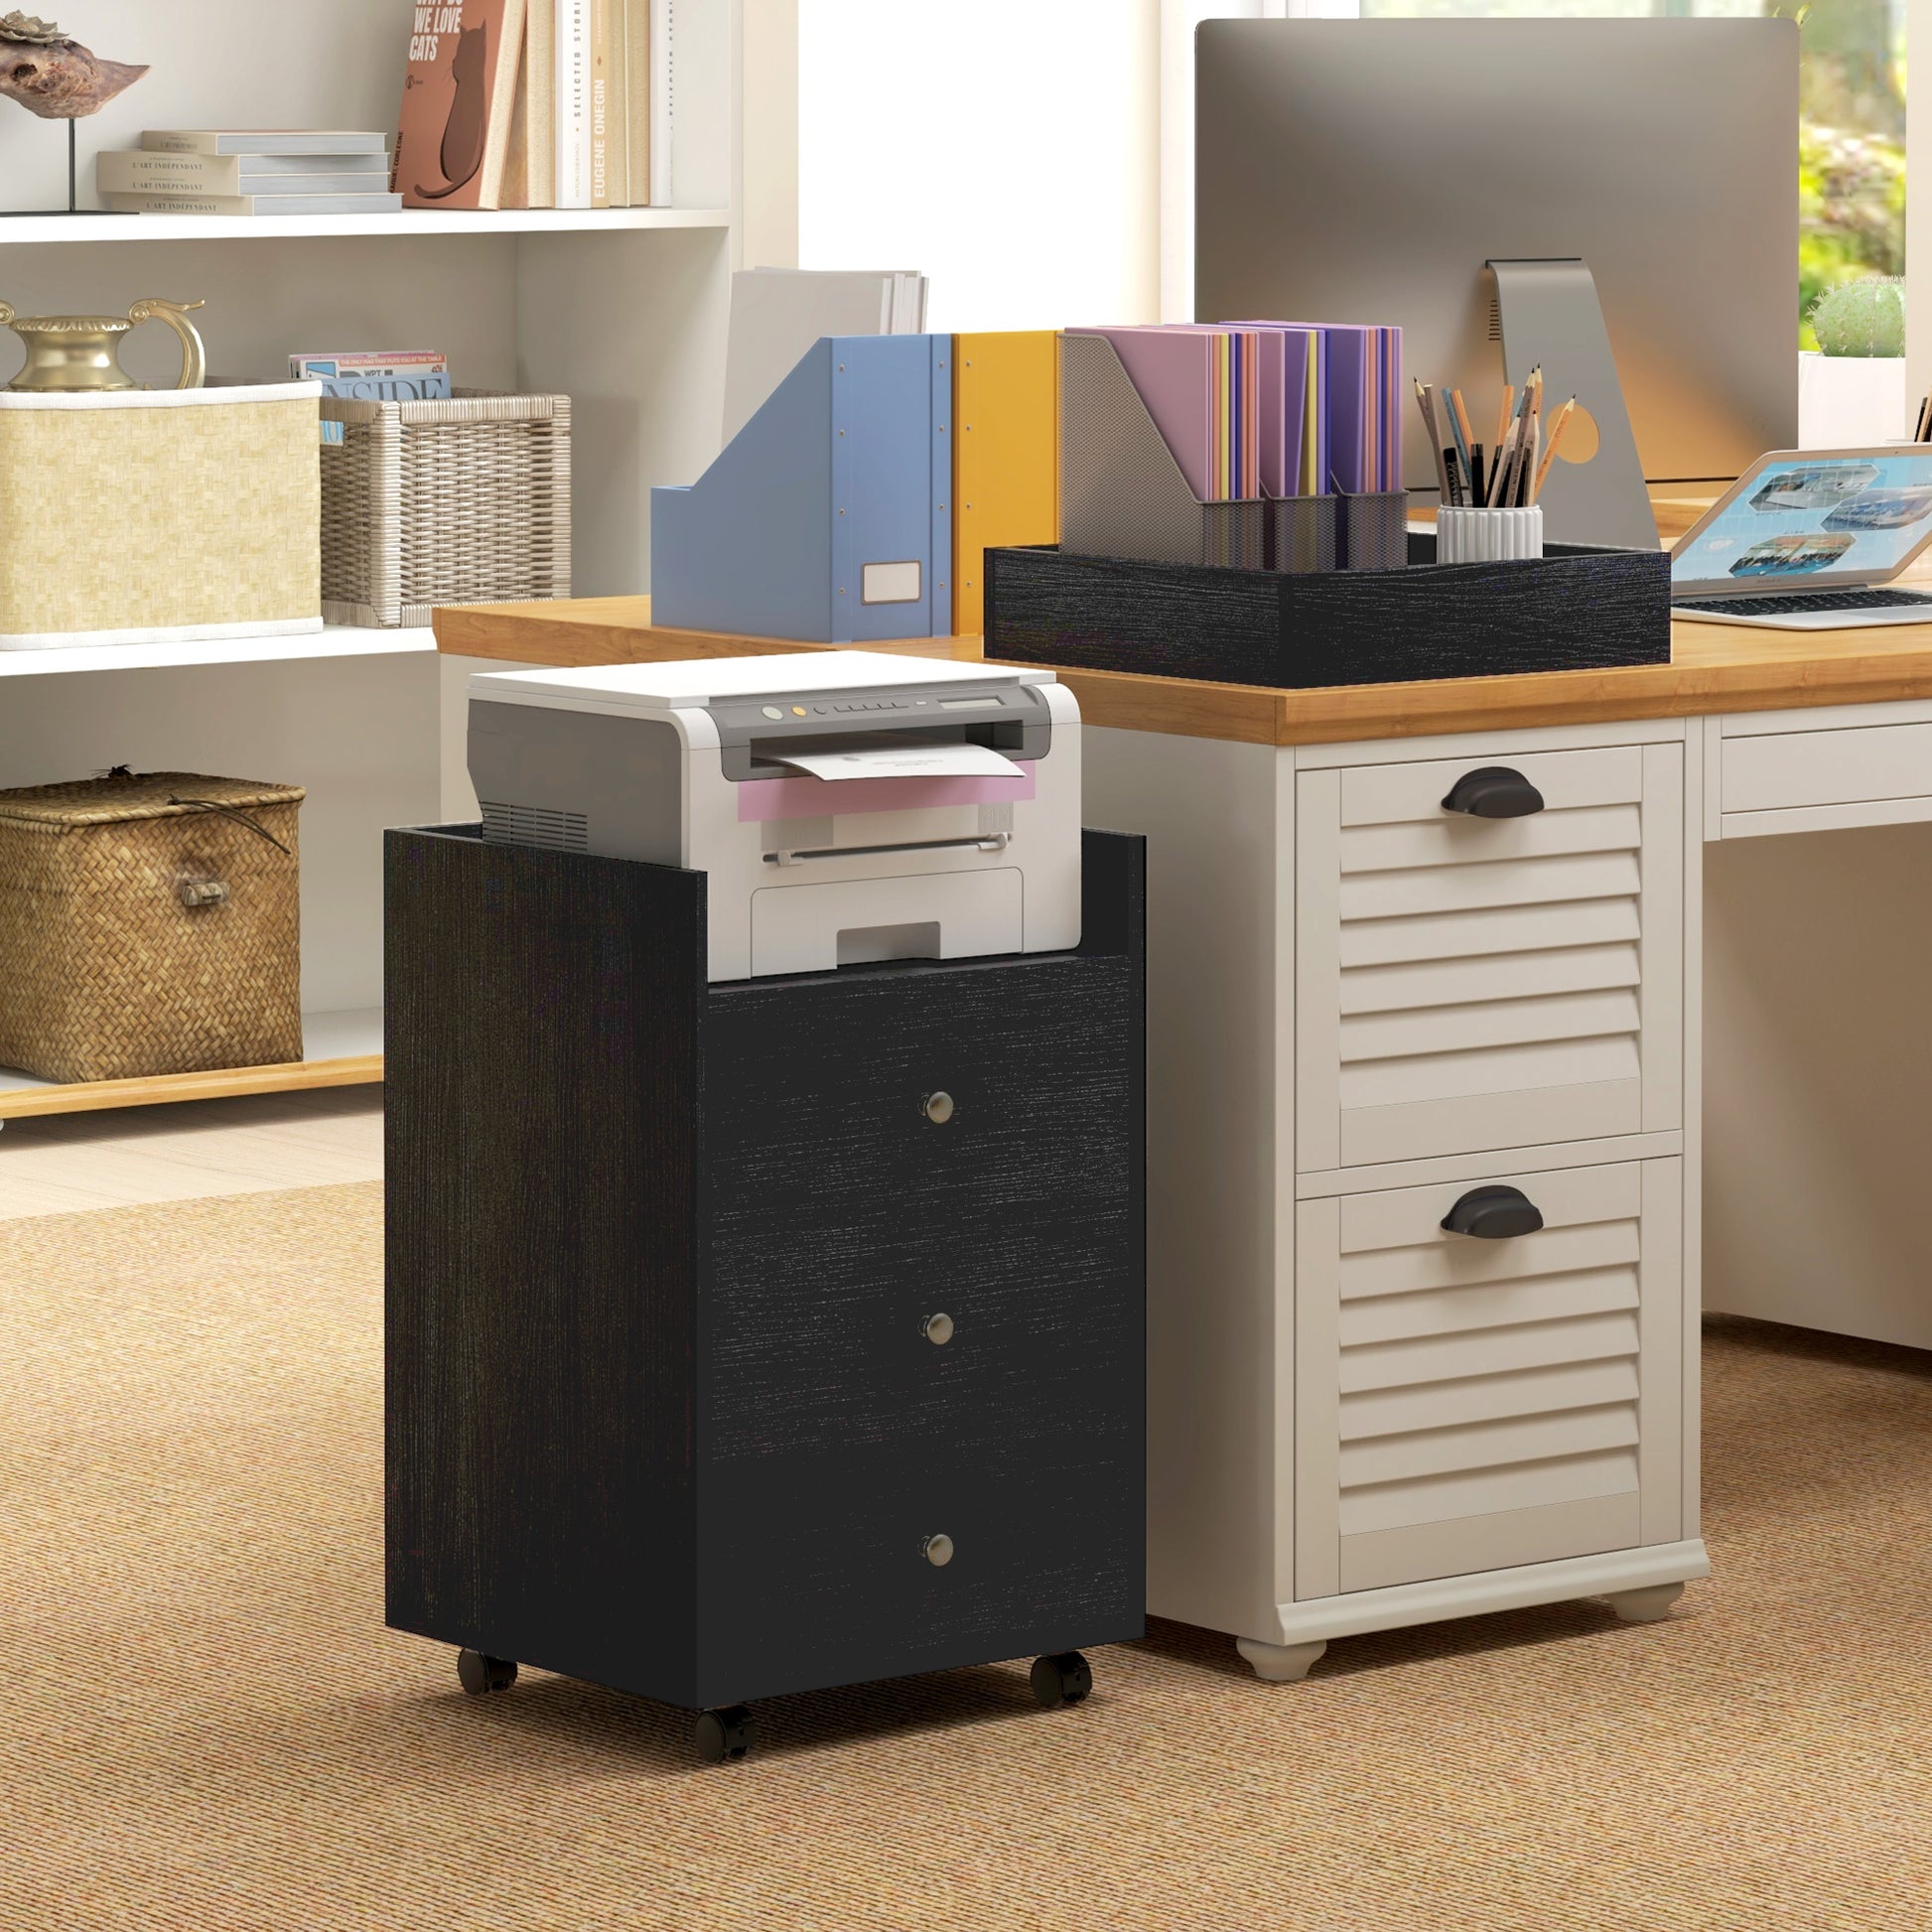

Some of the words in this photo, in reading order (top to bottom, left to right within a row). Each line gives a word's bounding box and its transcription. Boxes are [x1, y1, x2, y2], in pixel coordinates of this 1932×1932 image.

[414, 7, 433, 33] WE
[433, 7, 463, 33] LOVE
[409, 35, 439, 62] CATS
[594, 78, 606, 136] ONEGIN
[594, 139, 605, 199] EUGENE
